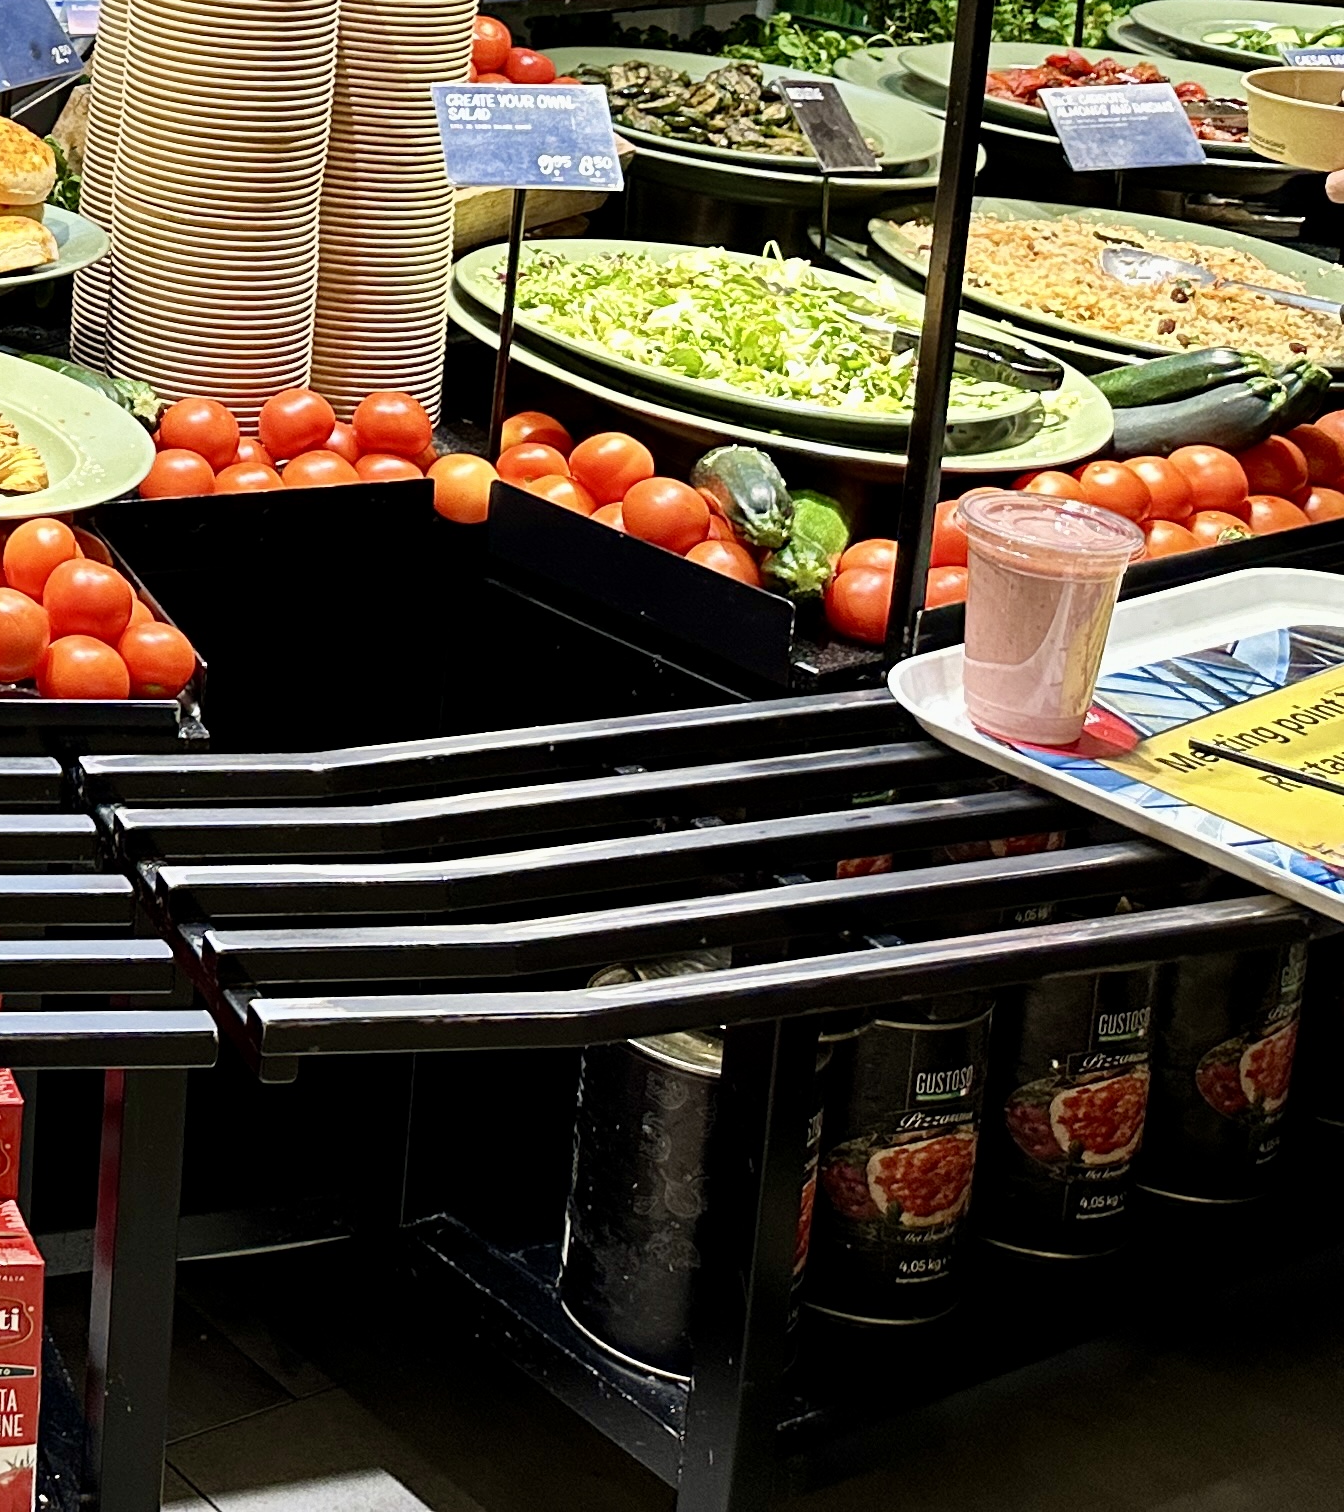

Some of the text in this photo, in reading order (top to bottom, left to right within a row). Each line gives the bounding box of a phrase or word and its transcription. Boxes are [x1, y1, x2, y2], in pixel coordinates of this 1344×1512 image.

[446, 94, 573, 109] CREATE YOUR OWN
[447, 108, 491, 120] SALAD
[1057, 105, 1109, 117] ALMONDS
[1110, 103, 1132, 114] AND
[1155, 698, 1344, 773] Meting point
[916, 1065, 973, 1094] GUSTOSO
[899, 1260, 926, 1274] 4,05
